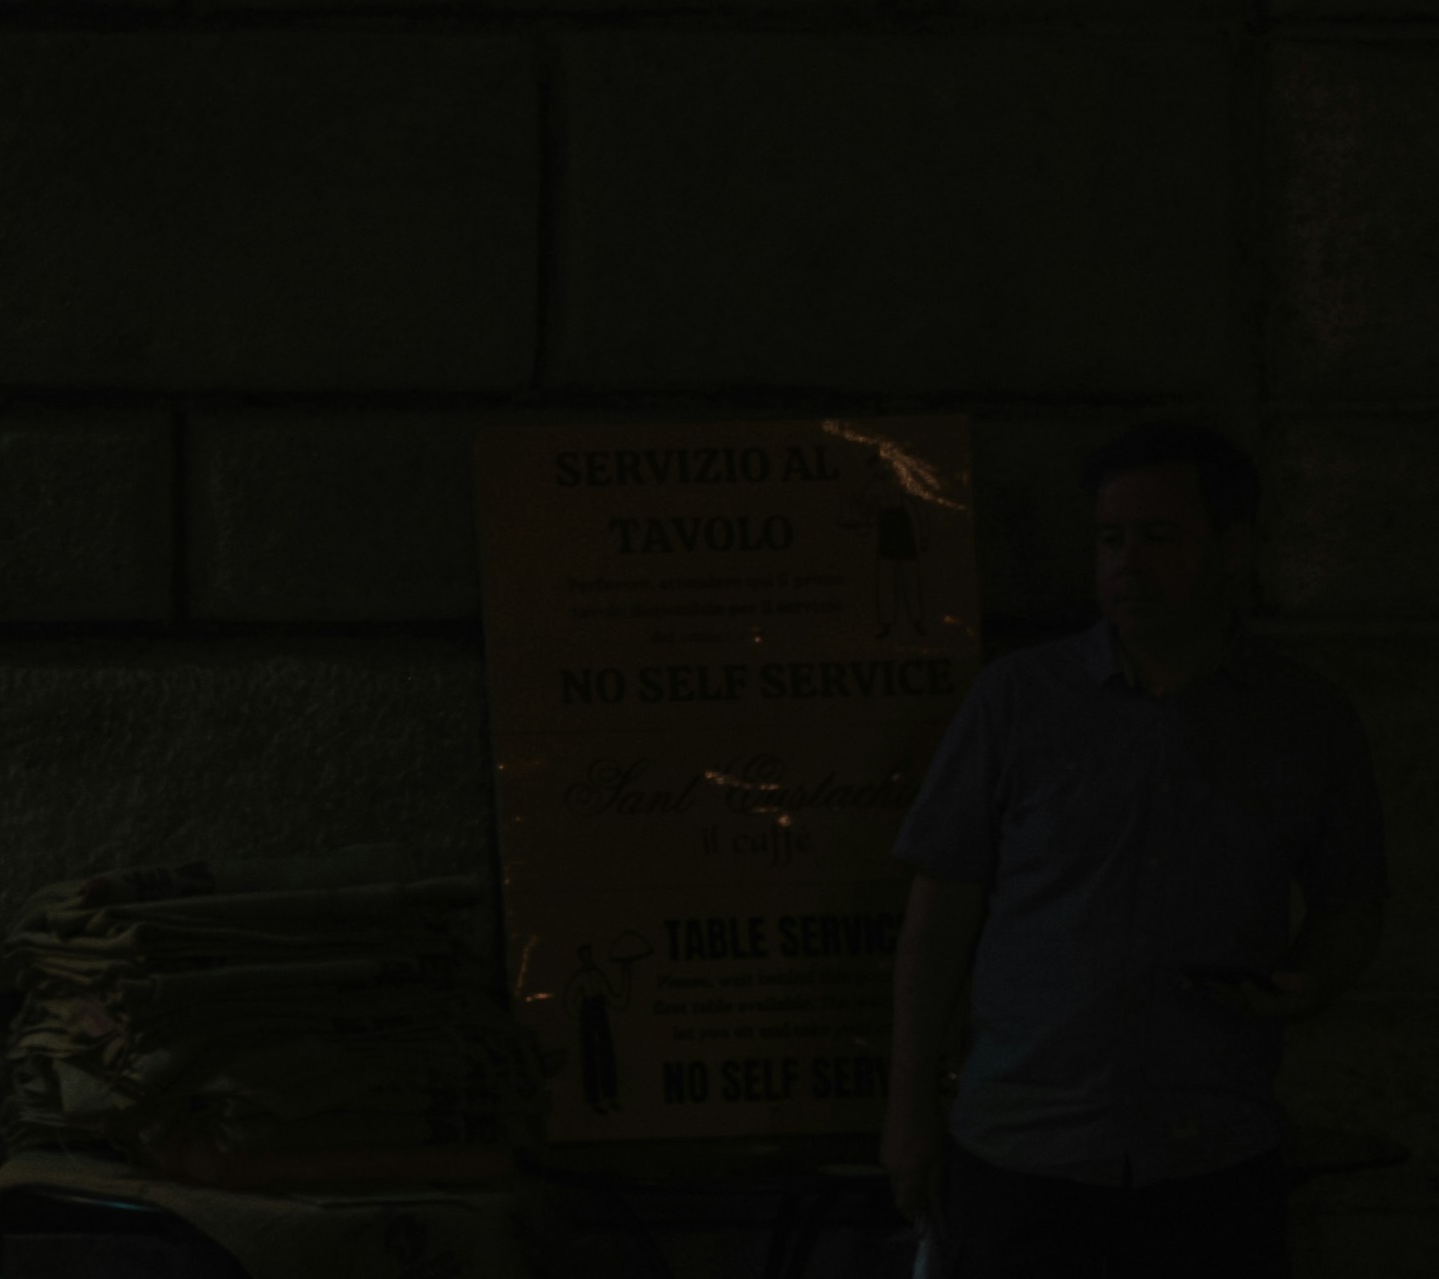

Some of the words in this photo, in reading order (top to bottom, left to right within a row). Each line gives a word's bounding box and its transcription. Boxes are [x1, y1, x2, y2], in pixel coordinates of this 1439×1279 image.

[555, 448, 771, 488] SERVIZIO
[781, 446, 841, 484] AL
[609, 515, 795, 555] TAVOLO
[561, 667, 627, 705] NO
[637, 664, 747, 704] SELF
[759, 658, 956, 700] SERVICE
[663, 914, 768, 962] TABLE
[778, 911, 905, 958] SERVIC
[662, 1060, 709, 1105] NO
[720, 1057, 801, 1102] SELF
